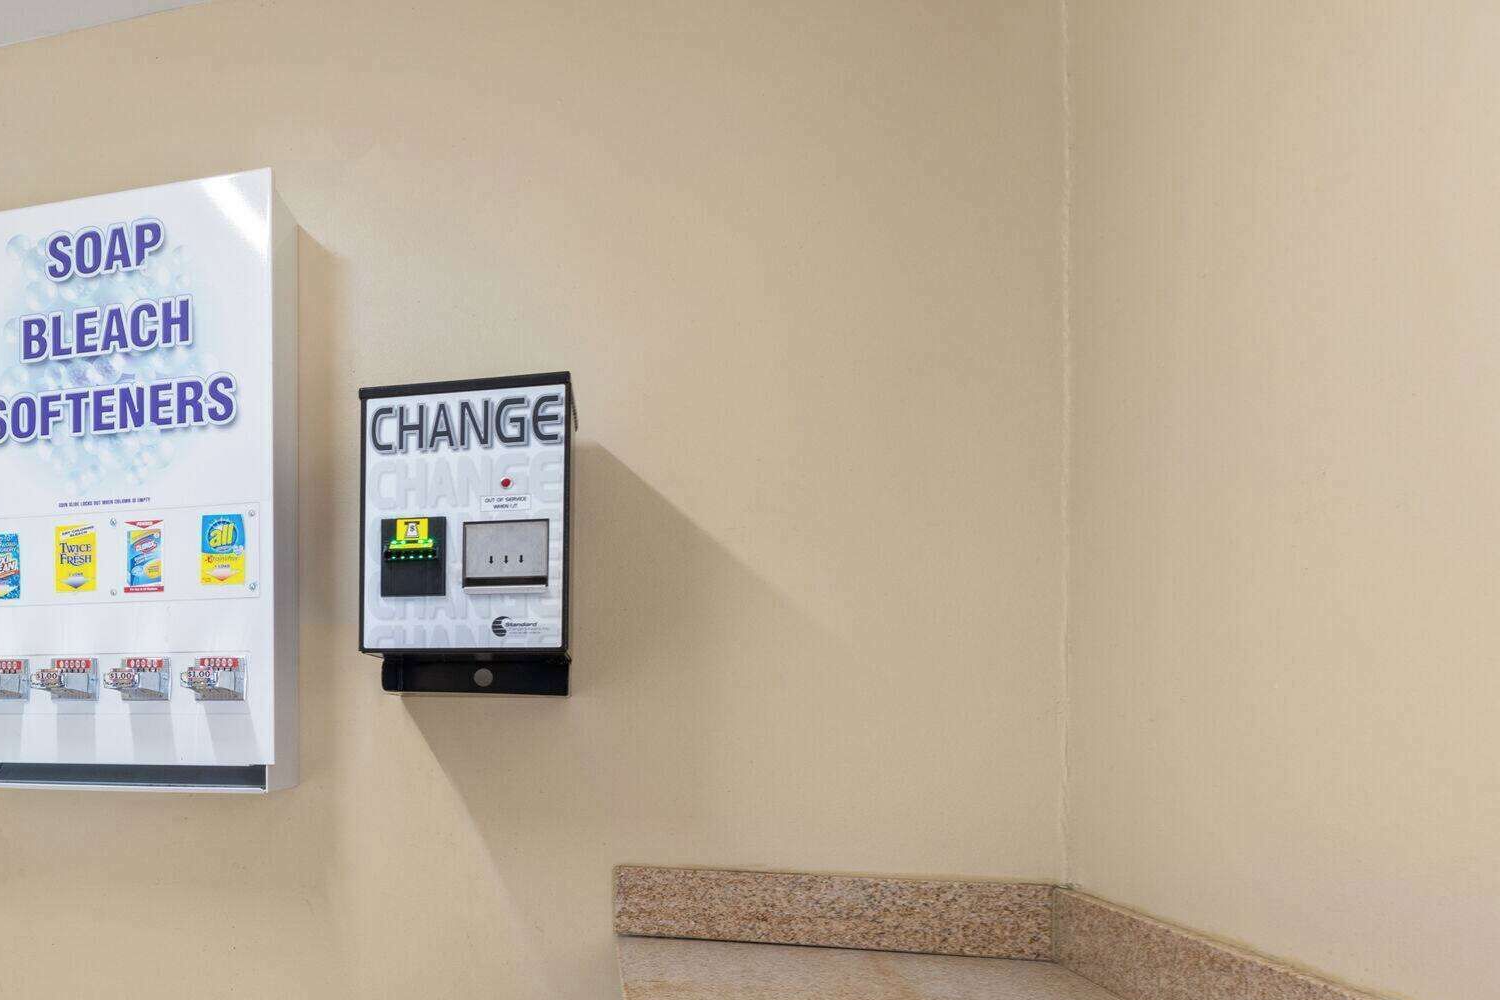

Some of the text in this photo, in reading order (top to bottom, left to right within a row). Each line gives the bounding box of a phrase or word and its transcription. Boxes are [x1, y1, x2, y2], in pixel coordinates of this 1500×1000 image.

[47, 221, 162, 279] SOAP
[22, 298, 190, 360] BLEACH
[370, 394, 560, 451] CHANGE
[209, 523, 235, 547] all
[59, 542, 92, 553] TWICE
[59, 553, 92, 566] FRESH
[36, 672, 57, 680] $1.00
[109, 672, 132, 680] $1.00
[187, 670, 211, 678] $1.00
